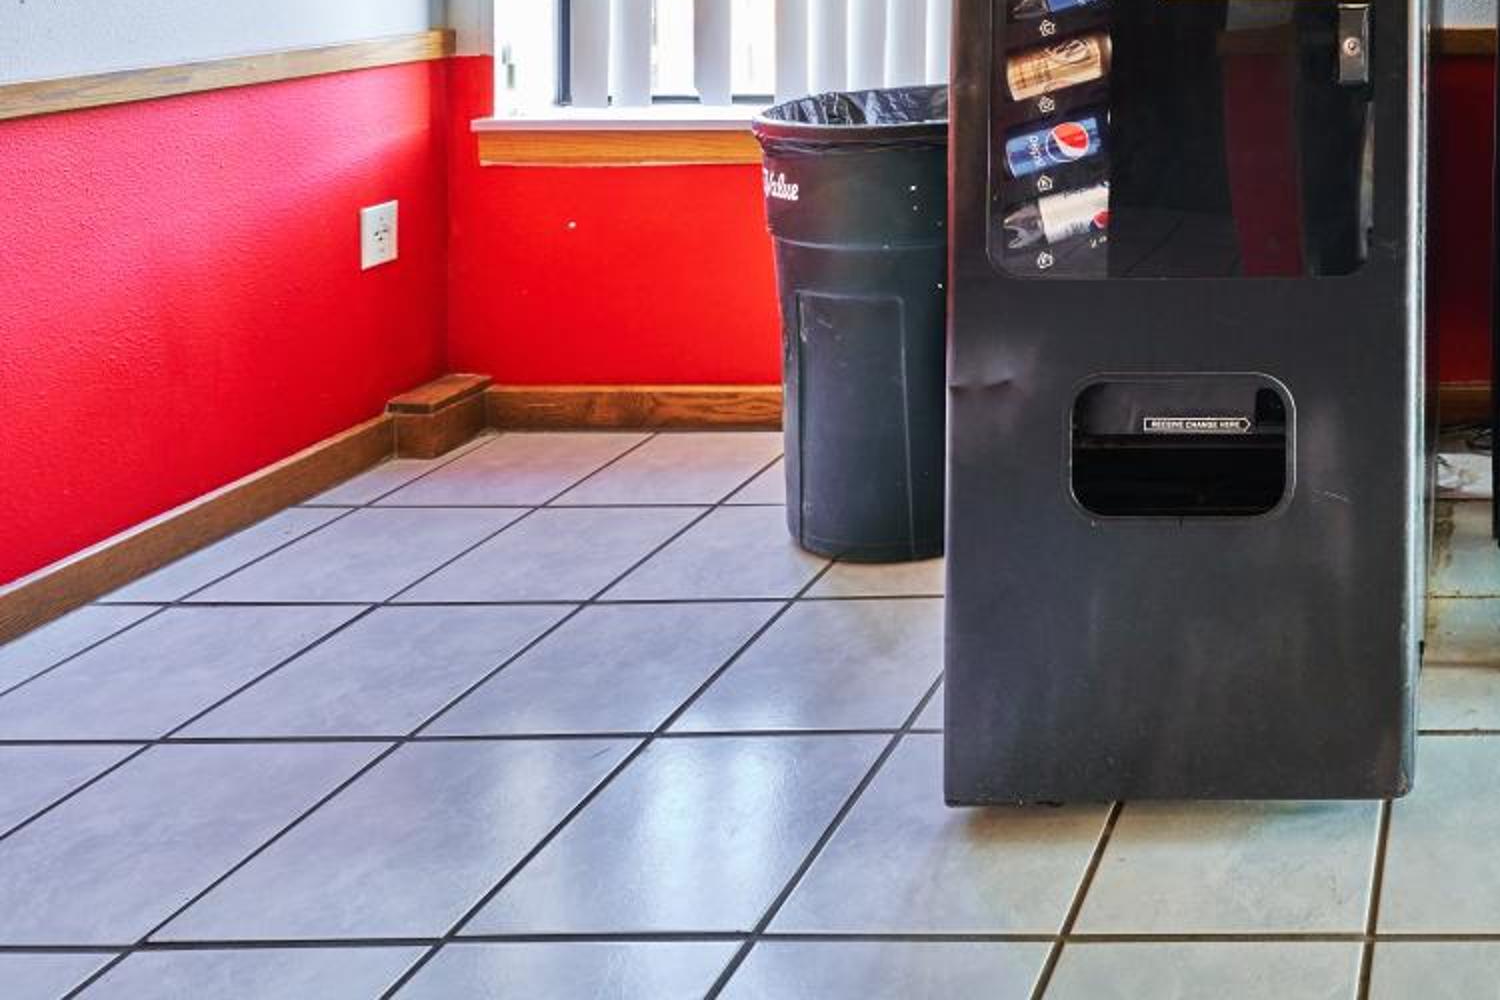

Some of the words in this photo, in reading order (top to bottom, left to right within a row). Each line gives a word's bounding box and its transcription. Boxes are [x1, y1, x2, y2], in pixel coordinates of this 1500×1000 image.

[763, 167, 800, 201] Value
[1186, 421, 1218, 429] CHANGE
[1220, 421, 1240, 429] HERE
